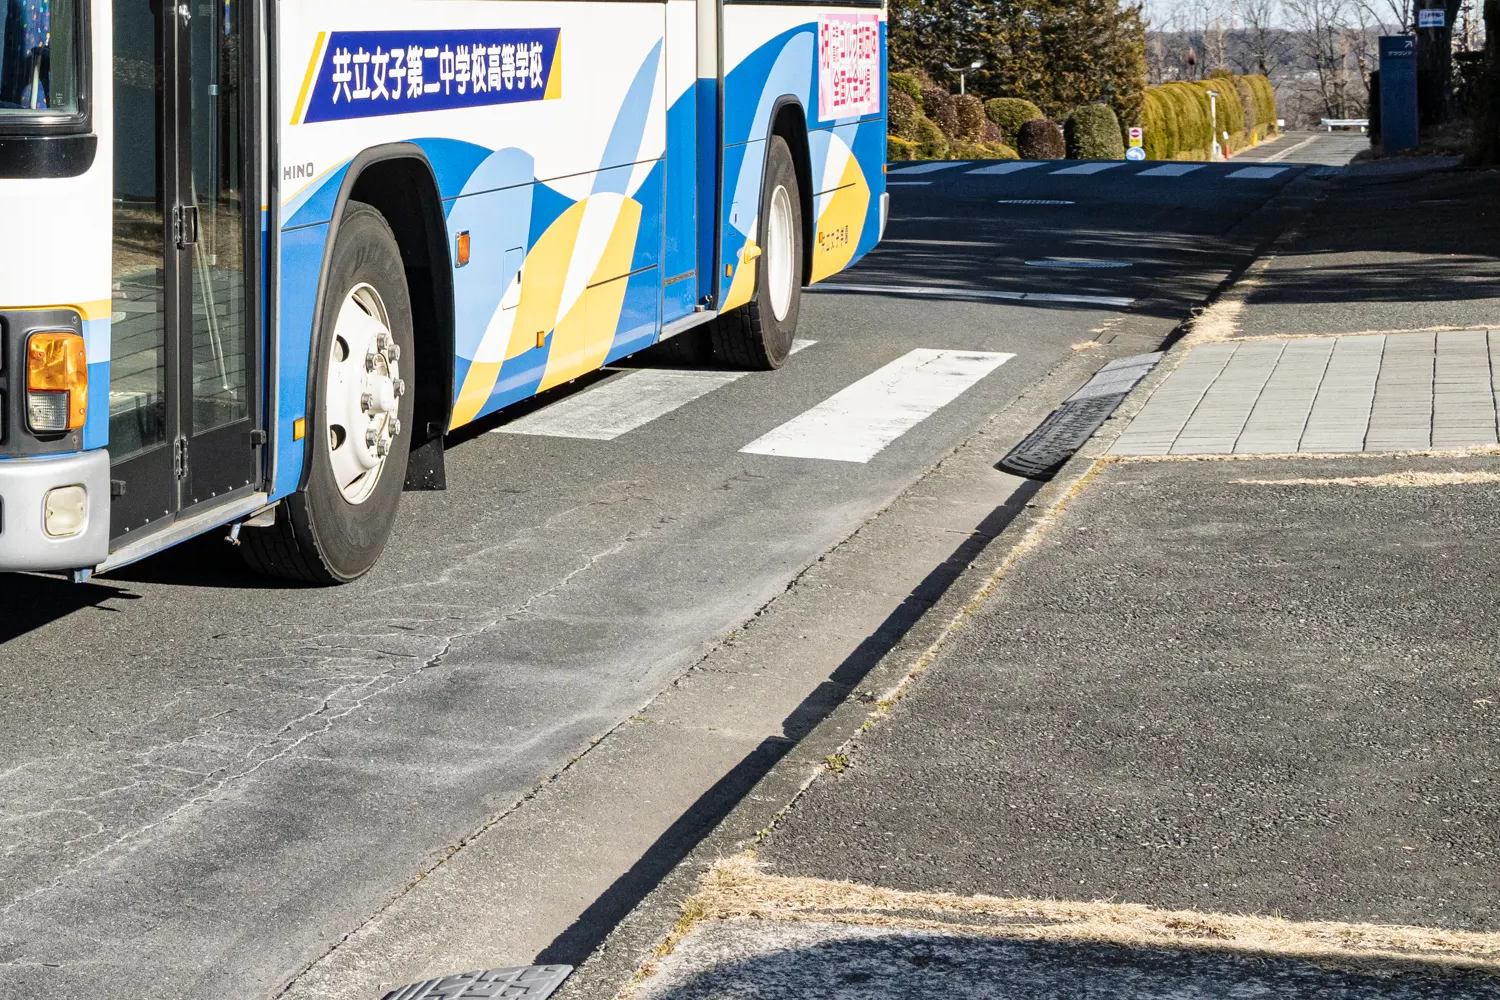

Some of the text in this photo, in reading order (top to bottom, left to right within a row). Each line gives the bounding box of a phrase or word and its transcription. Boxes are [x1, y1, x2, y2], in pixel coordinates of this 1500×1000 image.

[332, 40, 544, 105] 共立女子第二中学校高等学校
[283, 162, 315, 180] HINO
